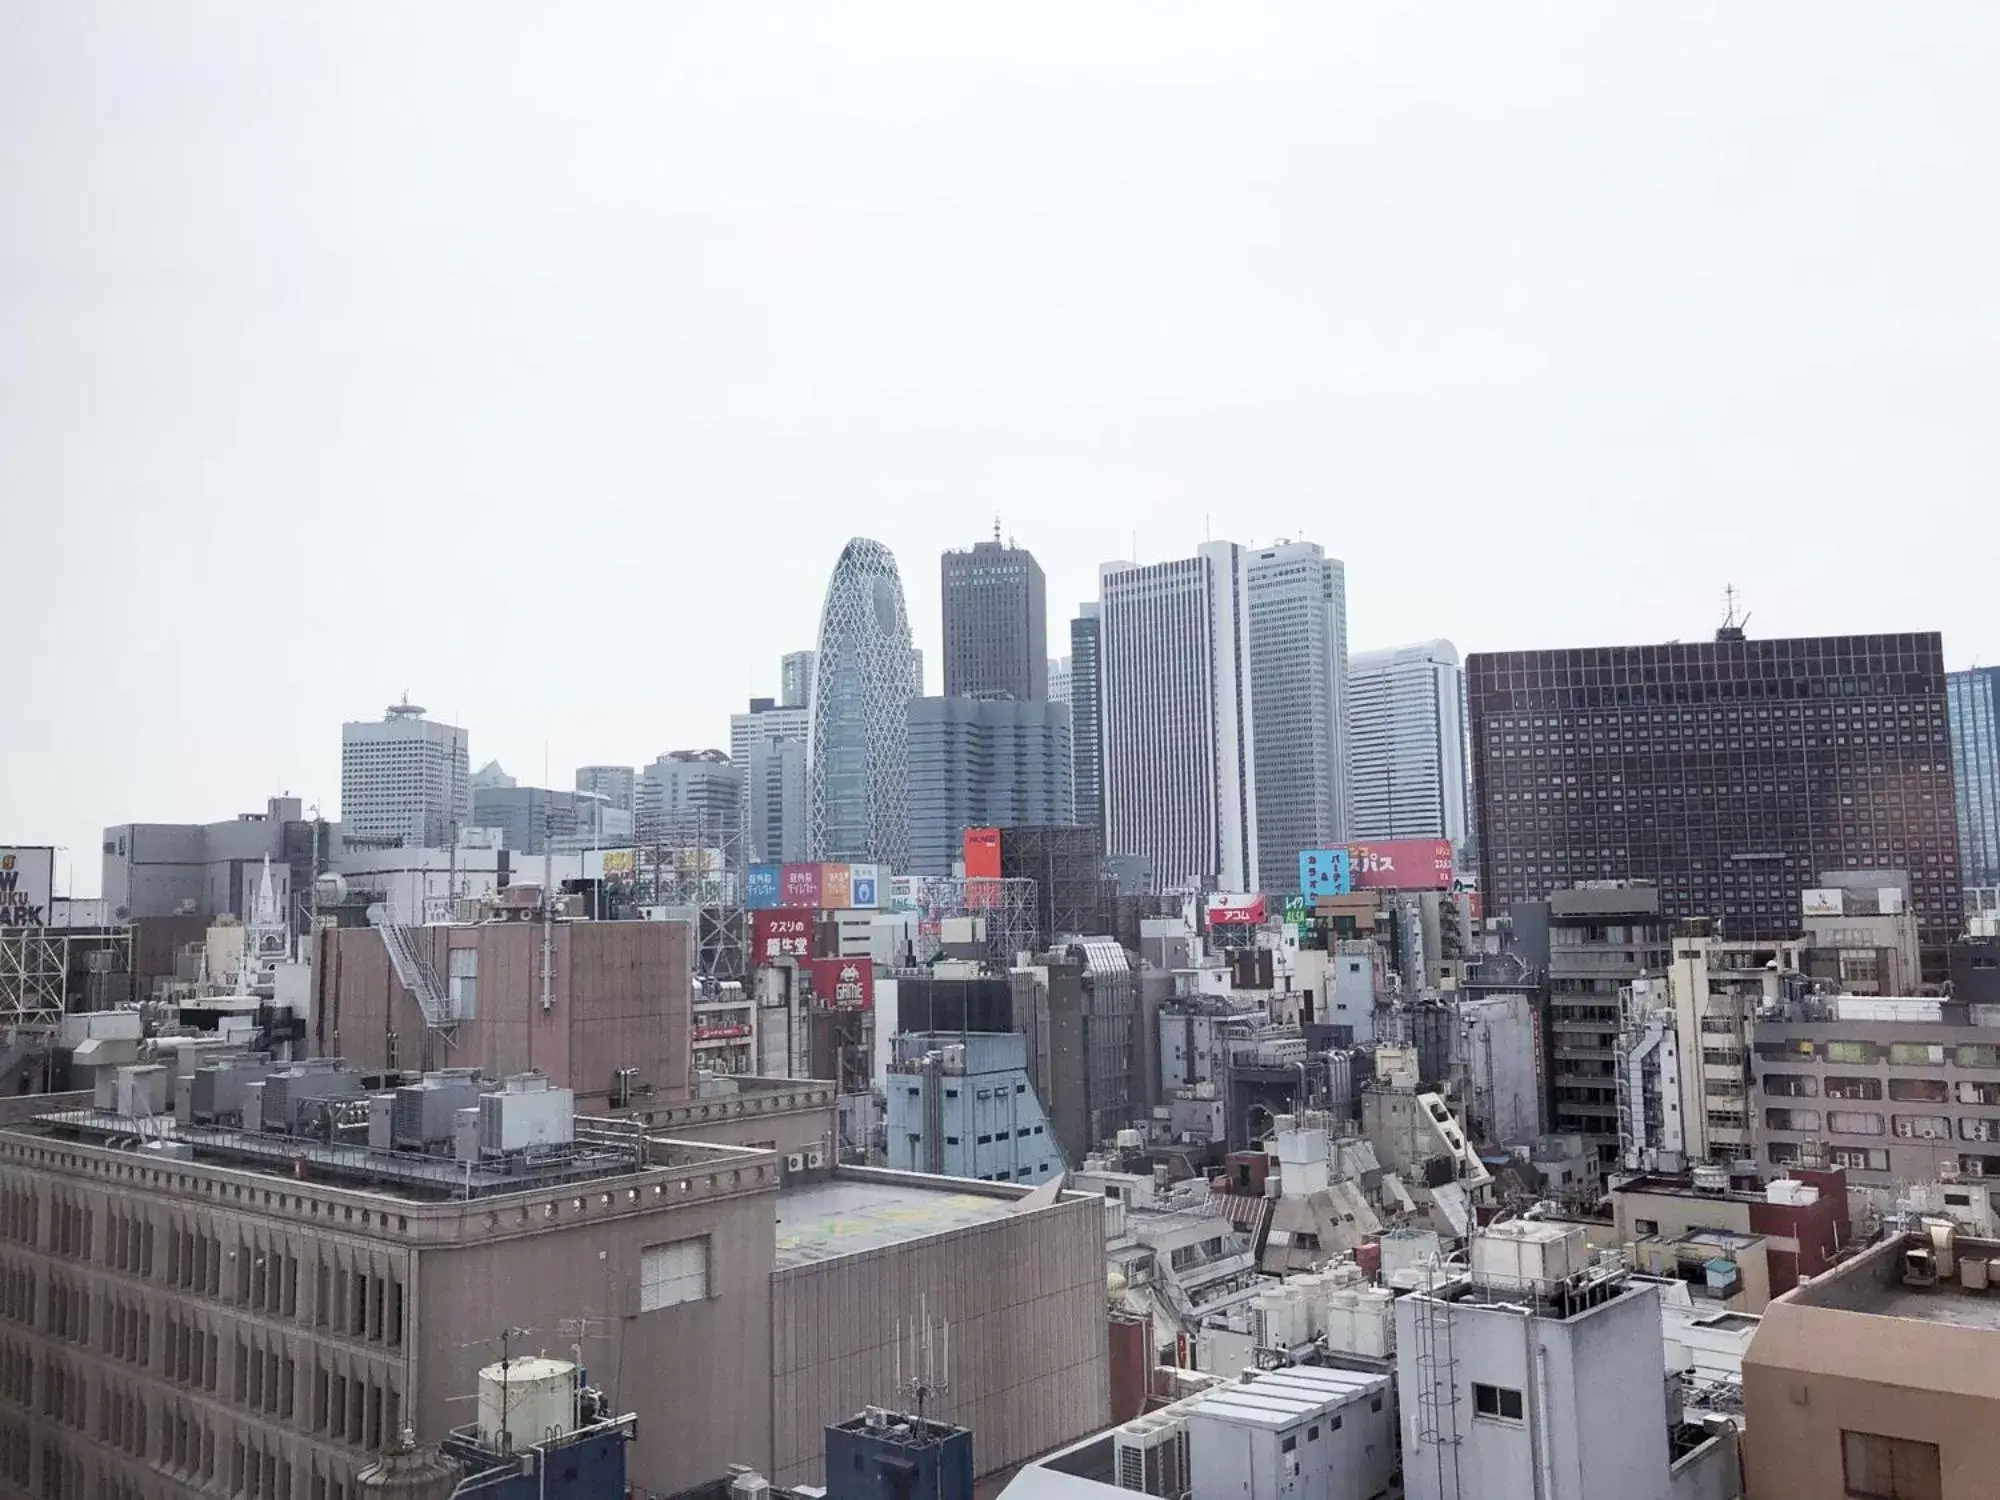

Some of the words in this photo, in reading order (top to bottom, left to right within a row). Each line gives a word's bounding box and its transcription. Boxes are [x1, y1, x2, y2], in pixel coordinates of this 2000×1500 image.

[1223, 910, 1250, 921] アコム
[769, 921, 805, 933] クスリの
[836, 982, 864, 1000] GAME
